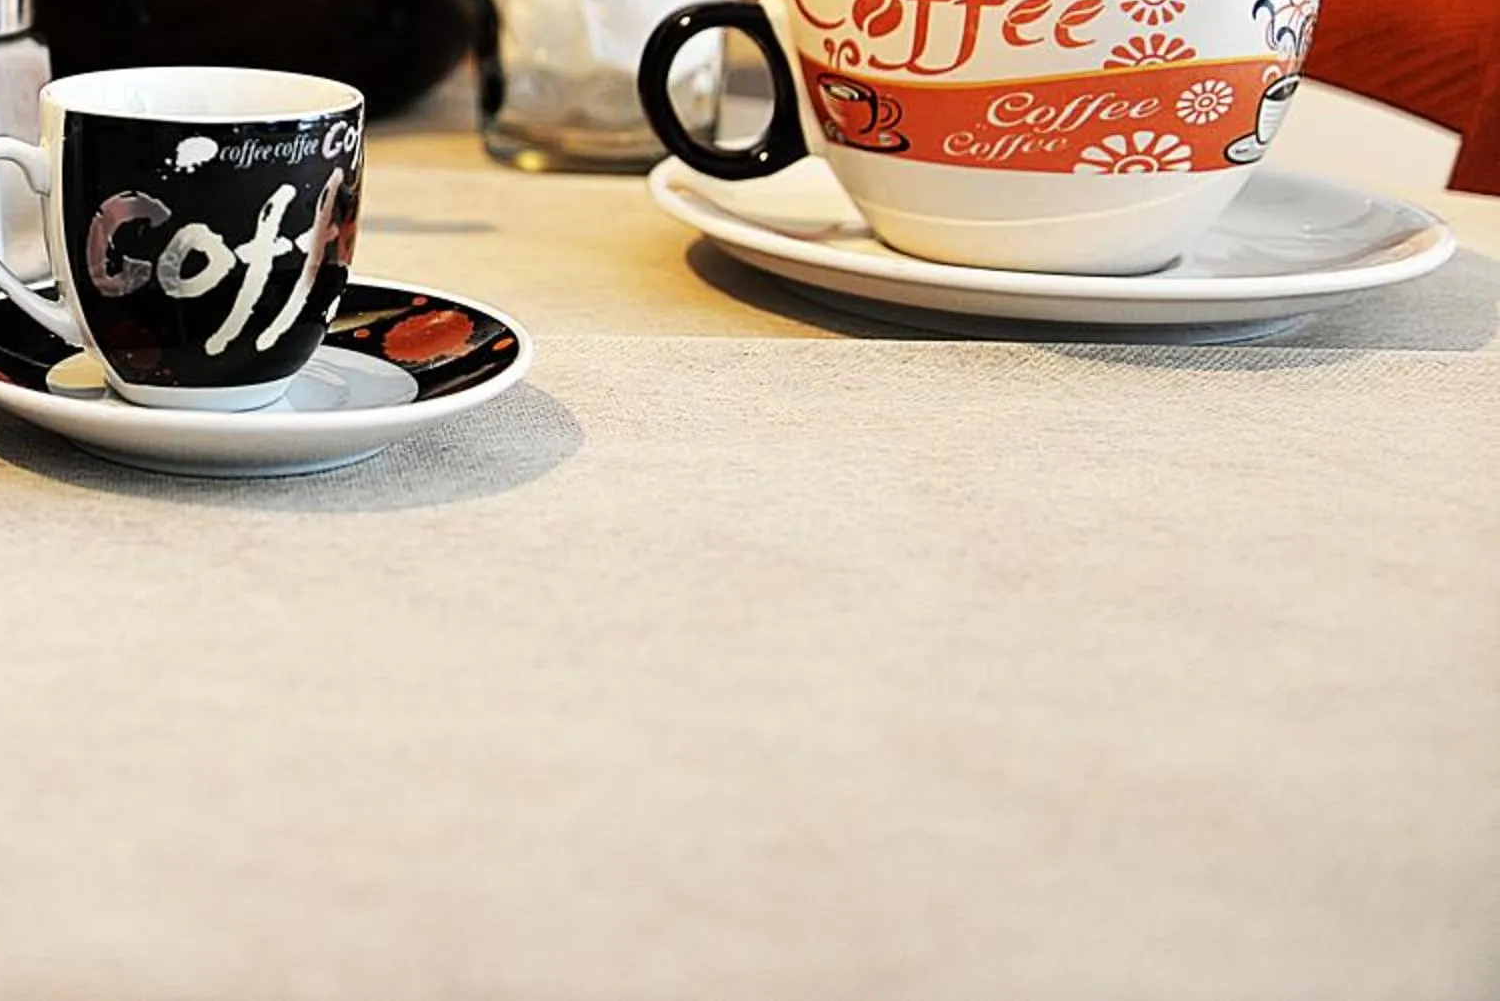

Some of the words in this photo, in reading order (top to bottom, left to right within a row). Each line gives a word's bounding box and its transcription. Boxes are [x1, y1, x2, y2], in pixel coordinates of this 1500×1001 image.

[986, 92, 1161, 133] Coffee
[219, 138, 273, 170] coffee
[273, 133, 319, 165] coffee
[943, 131, 1068, 161] Coffee
